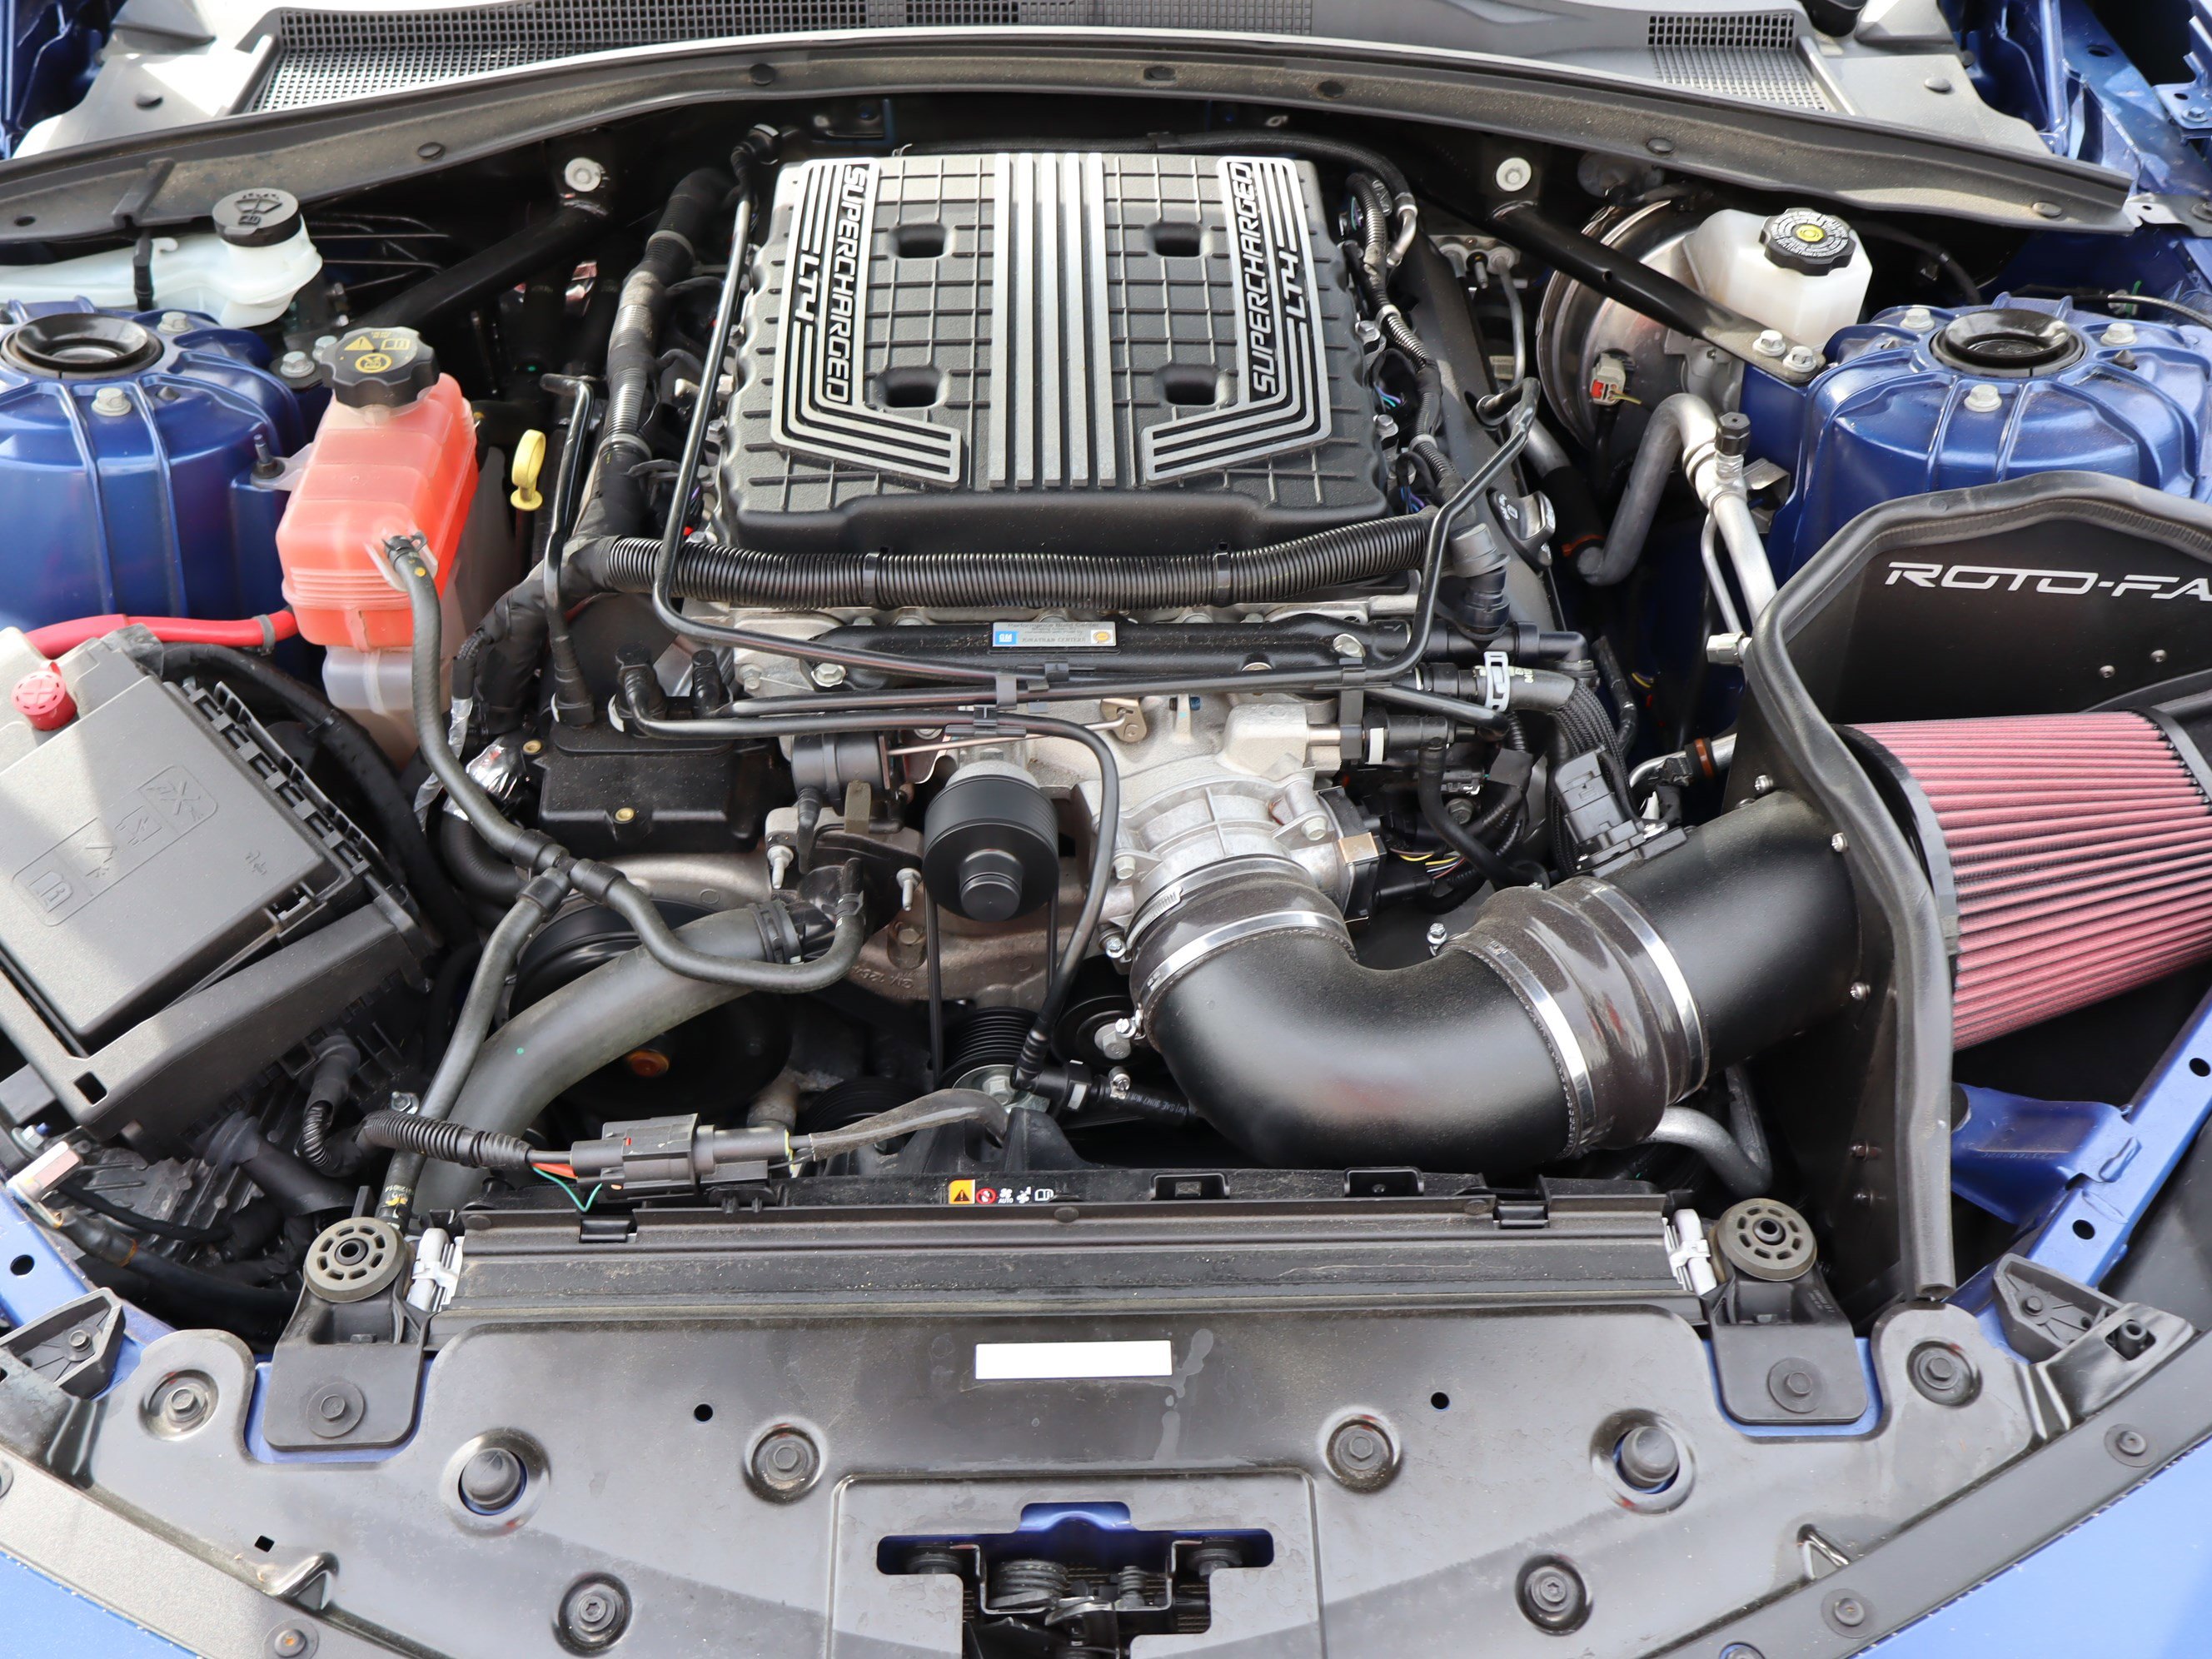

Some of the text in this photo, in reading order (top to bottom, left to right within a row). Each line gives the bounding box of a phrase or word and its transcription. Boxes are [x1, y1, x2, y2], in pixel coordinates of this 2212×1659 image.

[795, 253, 820, 321] LT4
[826, 165, 866, 403] SUPERCHARGED
[1229, 162, 1276, 395] SUPERCHARGED
[1278, 251, 1306, 318] LT4
[1885, 561, 2212, 601] ROTO-FA
[999, 634, 1013, 642] GM
